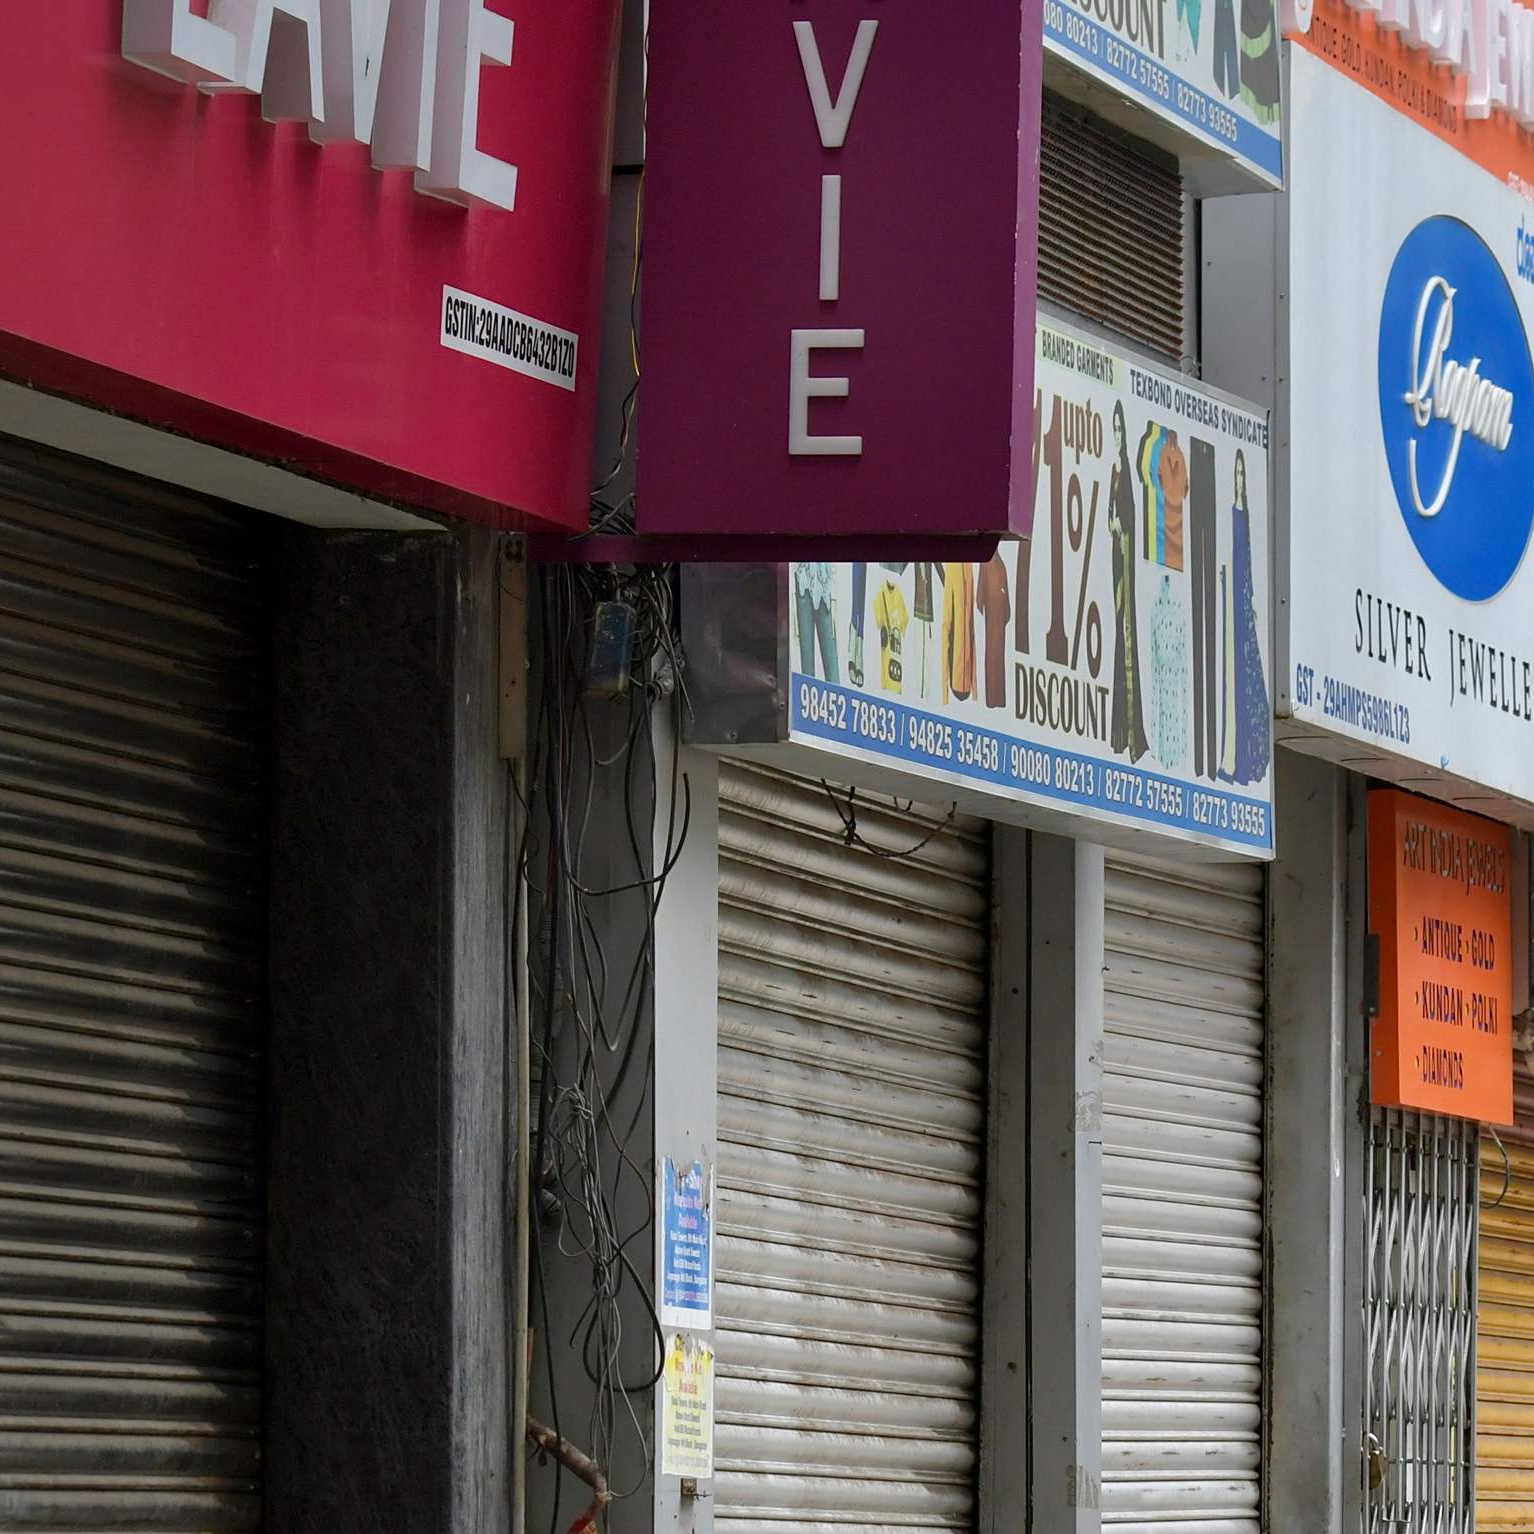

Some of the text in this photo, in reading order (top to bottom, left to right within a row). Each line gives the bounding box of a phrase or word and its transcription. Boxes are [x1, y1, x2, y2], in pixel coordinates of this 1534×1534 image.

[1067, 12, 1098, 55] 80213
[1107, 37, 1137, 80] 82772
[1140, 58, 1169, 99] 57555
[1177, 83, 1206, 123] 82773
[1209, 103, 1238, 142] 93555
[1042, 330, 1114, 385] BRANDED GARMENTS
[1064, 399, 1103, 464] upto
[1130, 369, 1267, 449] TEXBOND OVERSEAS SYNDICATE
[1355, 588, 1431, 681] SILVER
[1015, 662, 1109, 742] DISCOUNT
[1296, 663, 1314, 707] GST
[800, 683, 846, 729] 98452
[851, 698, 896, 744] 78833
[909, 715, 952, 760] 94825
[957, 728, 999, 772] 35458
[1011, 745, 1051, 786] 90080
[1055, 757, 1094, 796] 80213
[1105, 768, 1142, 808] 82772
[1147, 780, 1183, 818] 57555
[1193, 791, 1228, 829] 82773
[1231, 801, 1265, 838] 93555
[1403, 821, 1426, 874] ART
[1422, 915, 1495, 971] ANTIQUE GOLD
[1422, 980, 1498, 1035] KUNDAN POLKI
[1422, 1044, 1464, 1091] DIAMONDS
